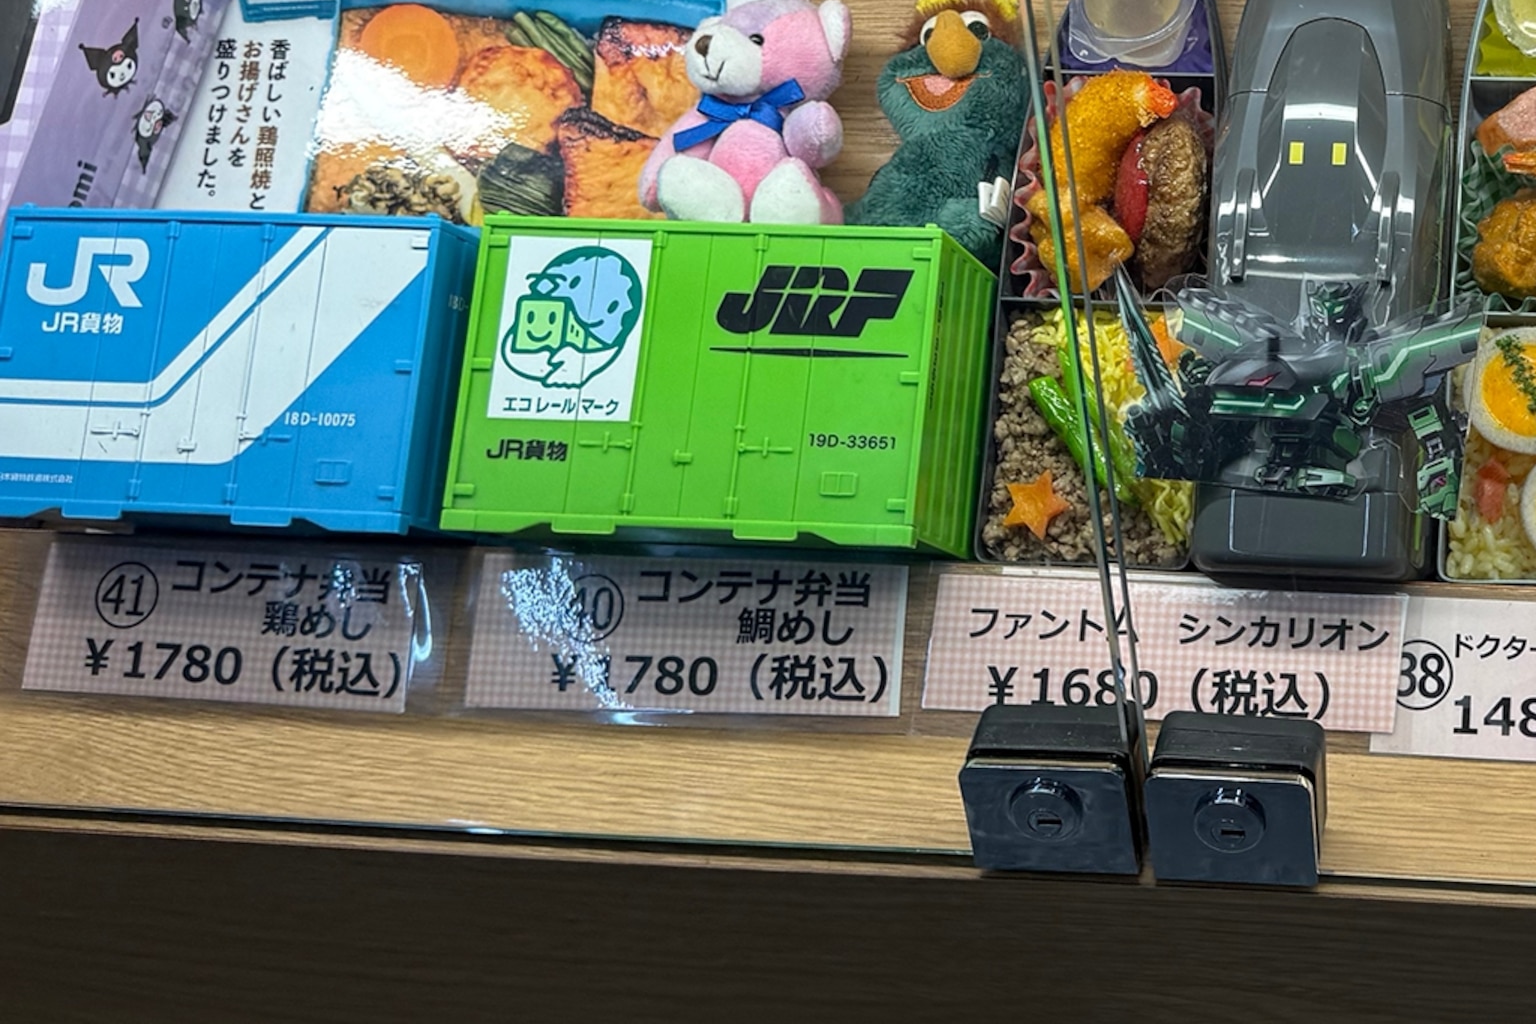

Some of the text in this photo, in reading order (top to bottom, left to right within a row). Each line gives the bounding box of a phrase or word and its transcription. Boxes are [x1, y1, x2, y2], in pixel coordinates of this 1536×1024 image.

[197, 38, 237, 198] 盛りつけました。
[228, 40, 263, 168] お揚げさんを
[249, 38, 291, 211] 香ばしい鶏照焼と
[26, 236, 151, 308] JR
[42, 311, 124, 335] JR貨物
[486, 438, 569, 462] JR貨物
[808, 432, 897, 451] 19D-33651
[172, 559, 390, 605] コンテナ弁当
[637, 569, 871, 608] コンテナ弁当
[261, 600, 373, 641] 鶏めし
[735, 606, 854, 645] 鯛めし
[1178, 612, 1390, 652] シンカリオン
